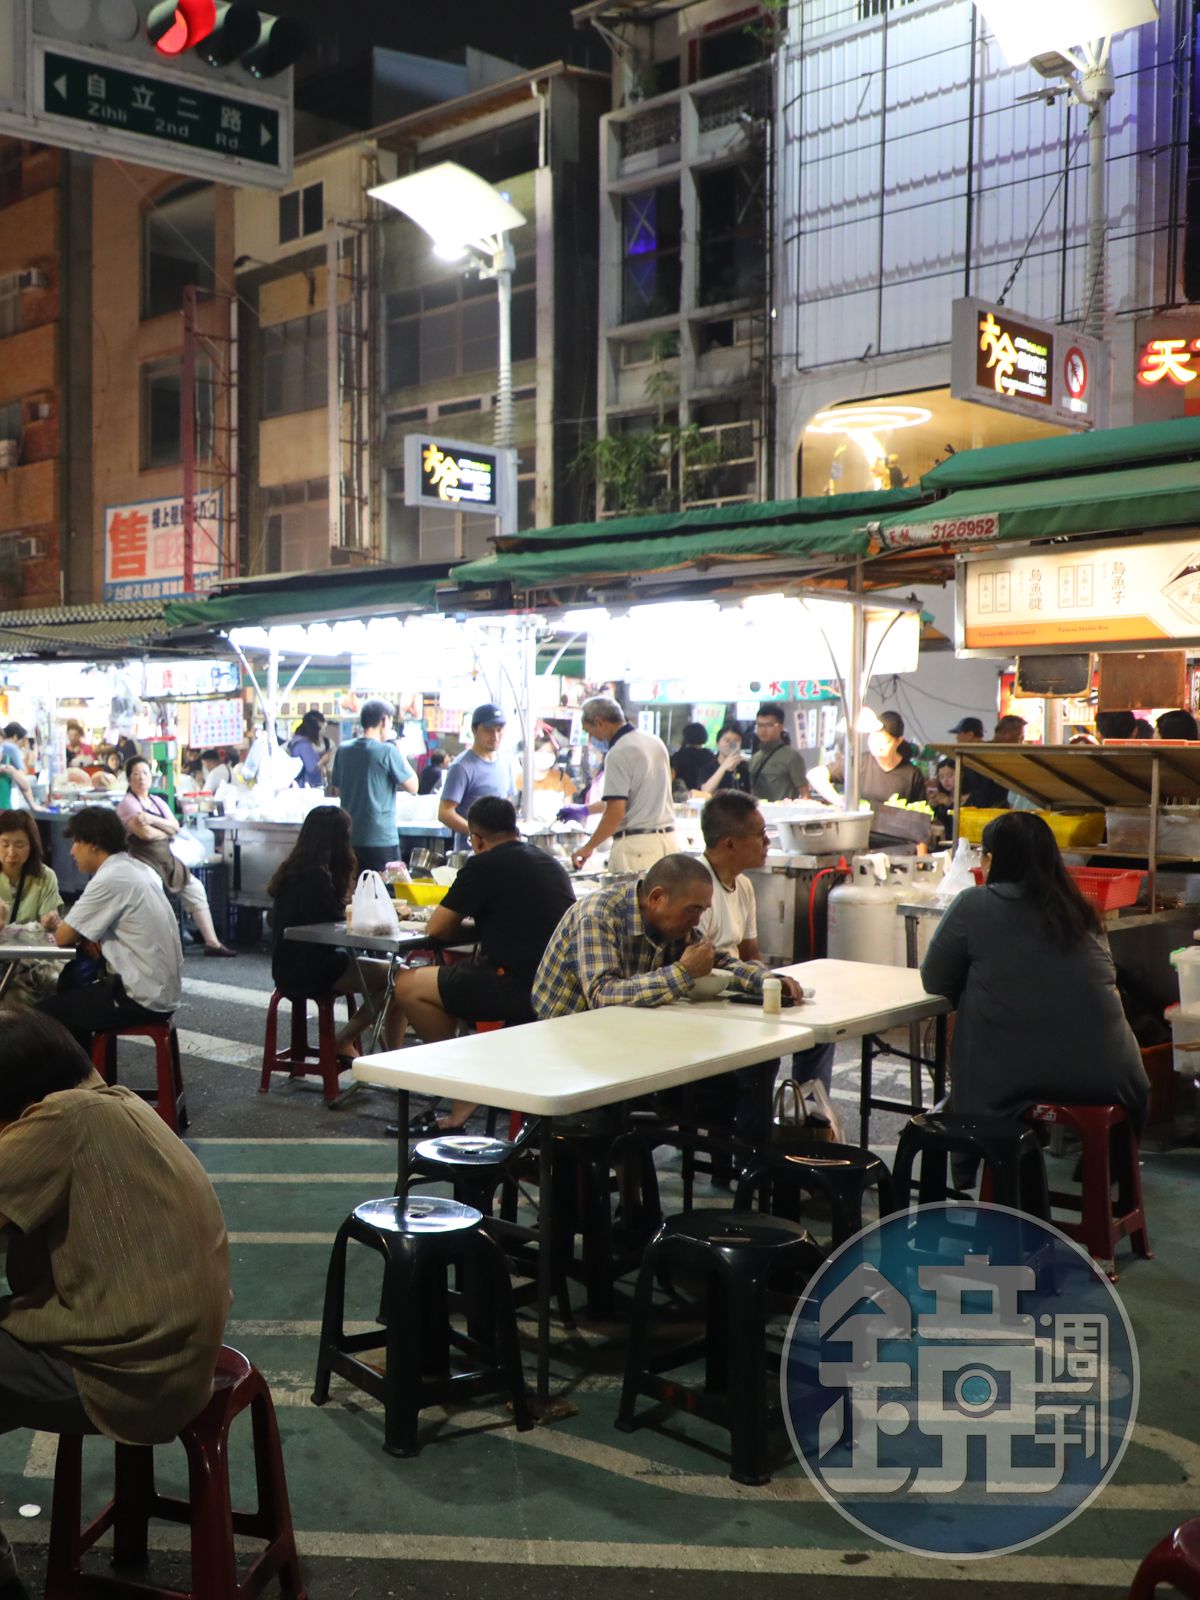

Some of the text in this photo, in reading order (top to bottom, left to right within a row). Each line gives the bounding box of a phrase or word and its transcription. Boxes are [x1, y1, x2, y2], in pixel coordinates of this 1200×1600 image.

[87, 72, 241, 133] 自立二路
[88, 102, 239, 150] Zihli 2nd Rd
[1138, 338, 1200, 385] 天
[108, 509, 149, 579] 售
[931, 518, 995, 540] 3126952
